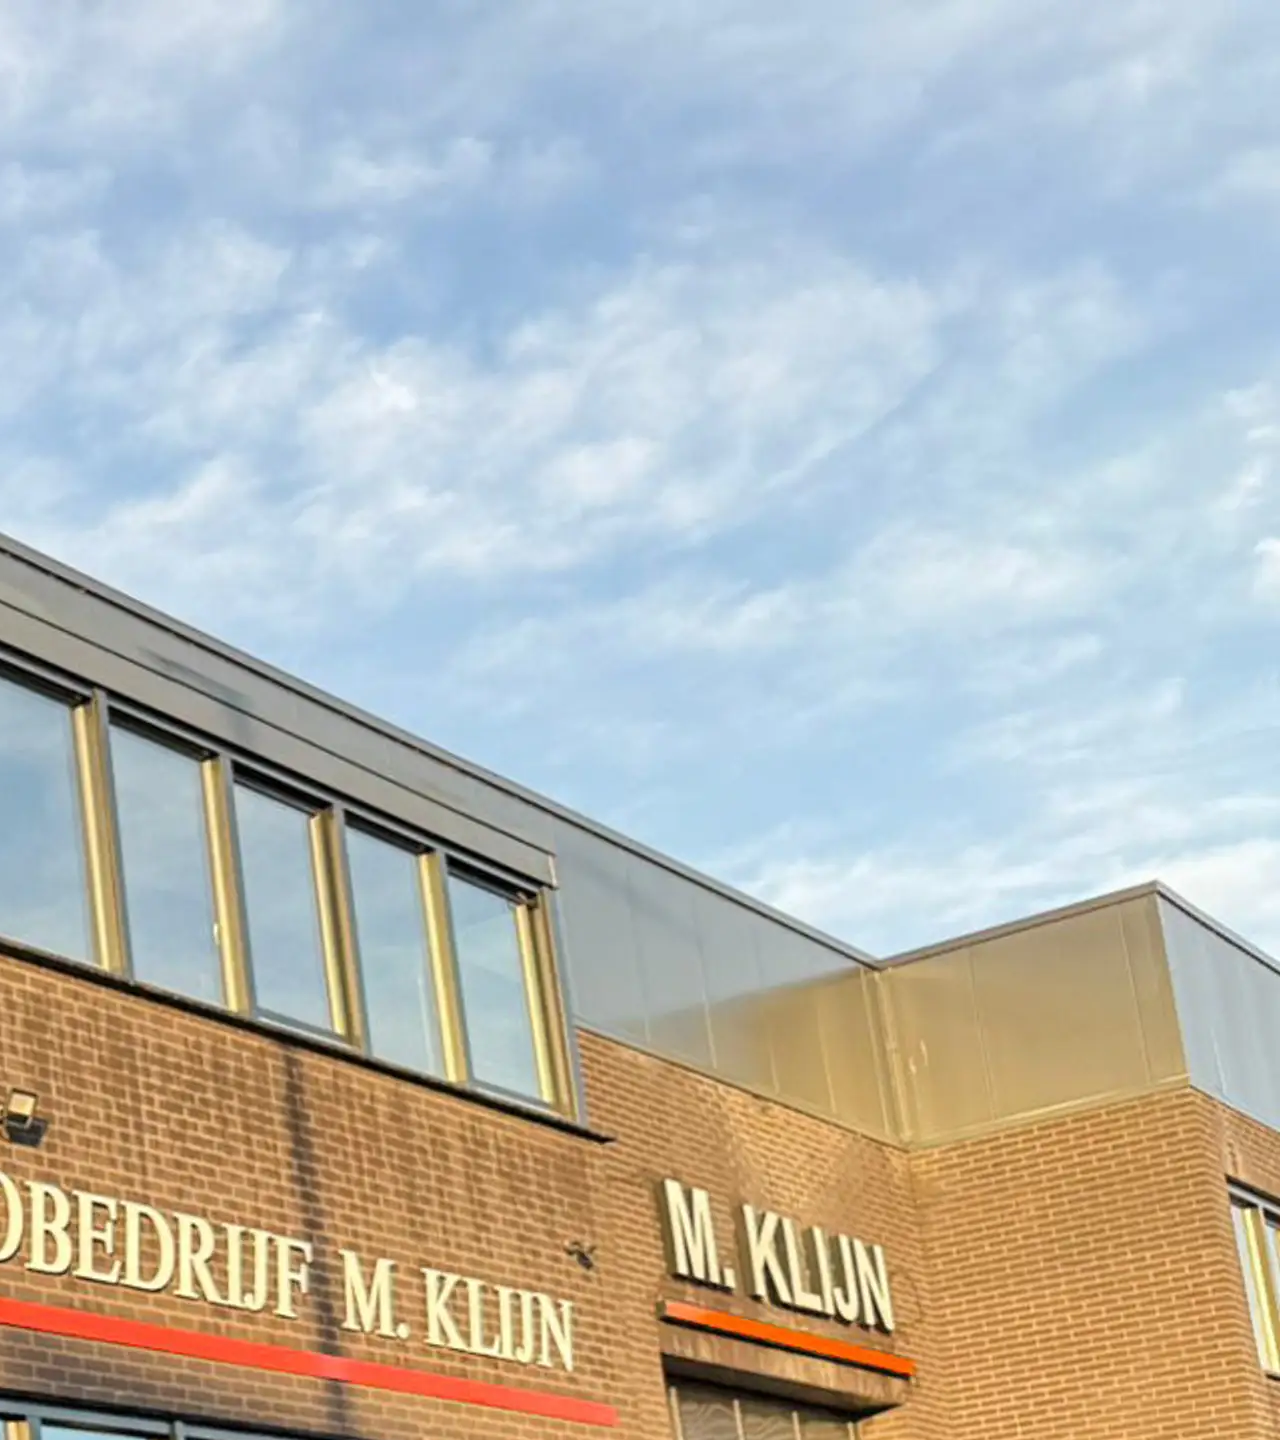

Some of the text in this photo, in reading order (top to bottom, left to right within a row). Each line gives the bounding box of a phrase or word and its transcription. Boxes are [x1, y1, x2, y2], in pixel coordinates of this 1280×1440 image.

[339, 1249, 410, 1340] M.
[420, 1267, 574, 1373] KLIJN
[664, 1178, 895, 1331] M. KLIJN
